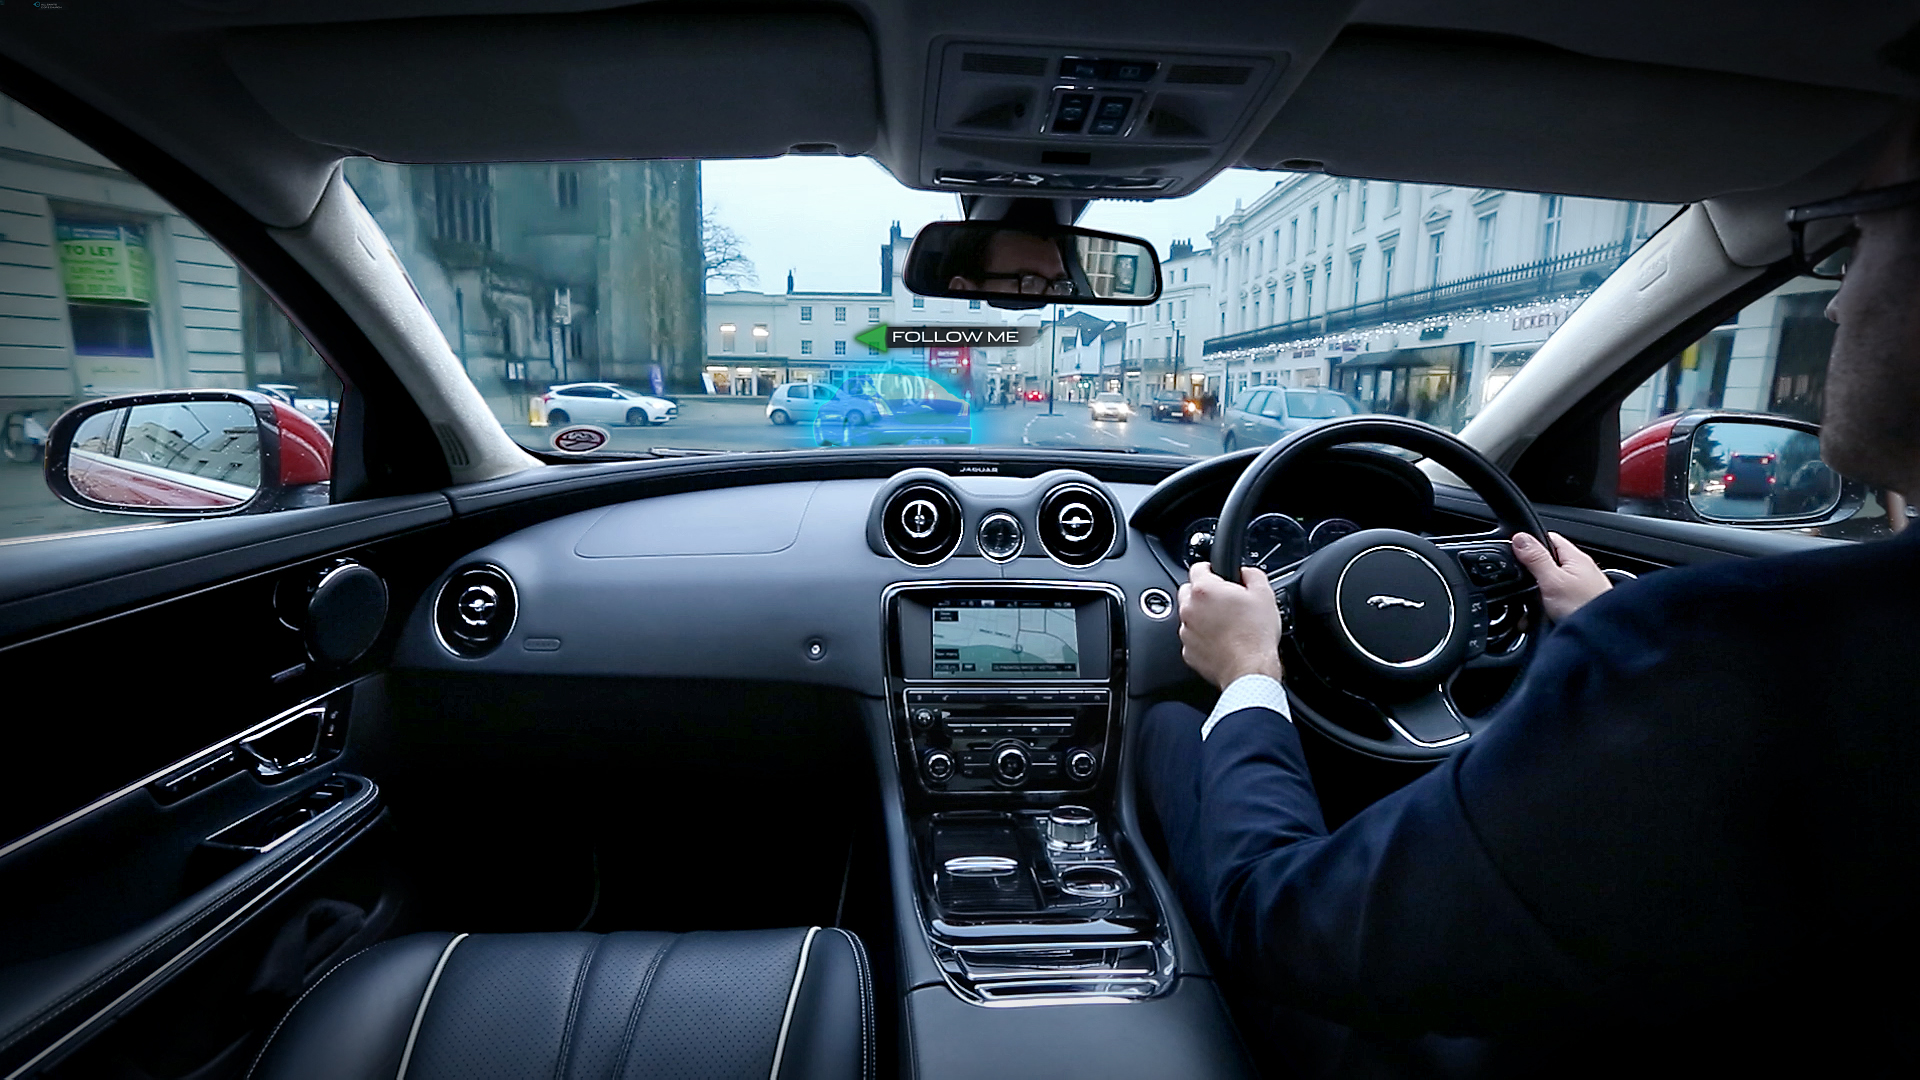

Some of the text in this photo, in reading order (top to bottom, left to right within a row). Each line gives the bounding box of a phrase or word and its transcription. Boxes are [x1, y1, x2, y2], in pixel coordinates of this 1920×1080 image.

[64, 244, 114, 257] TO LET
[1512, 312, 1561, 331] LICKETY
